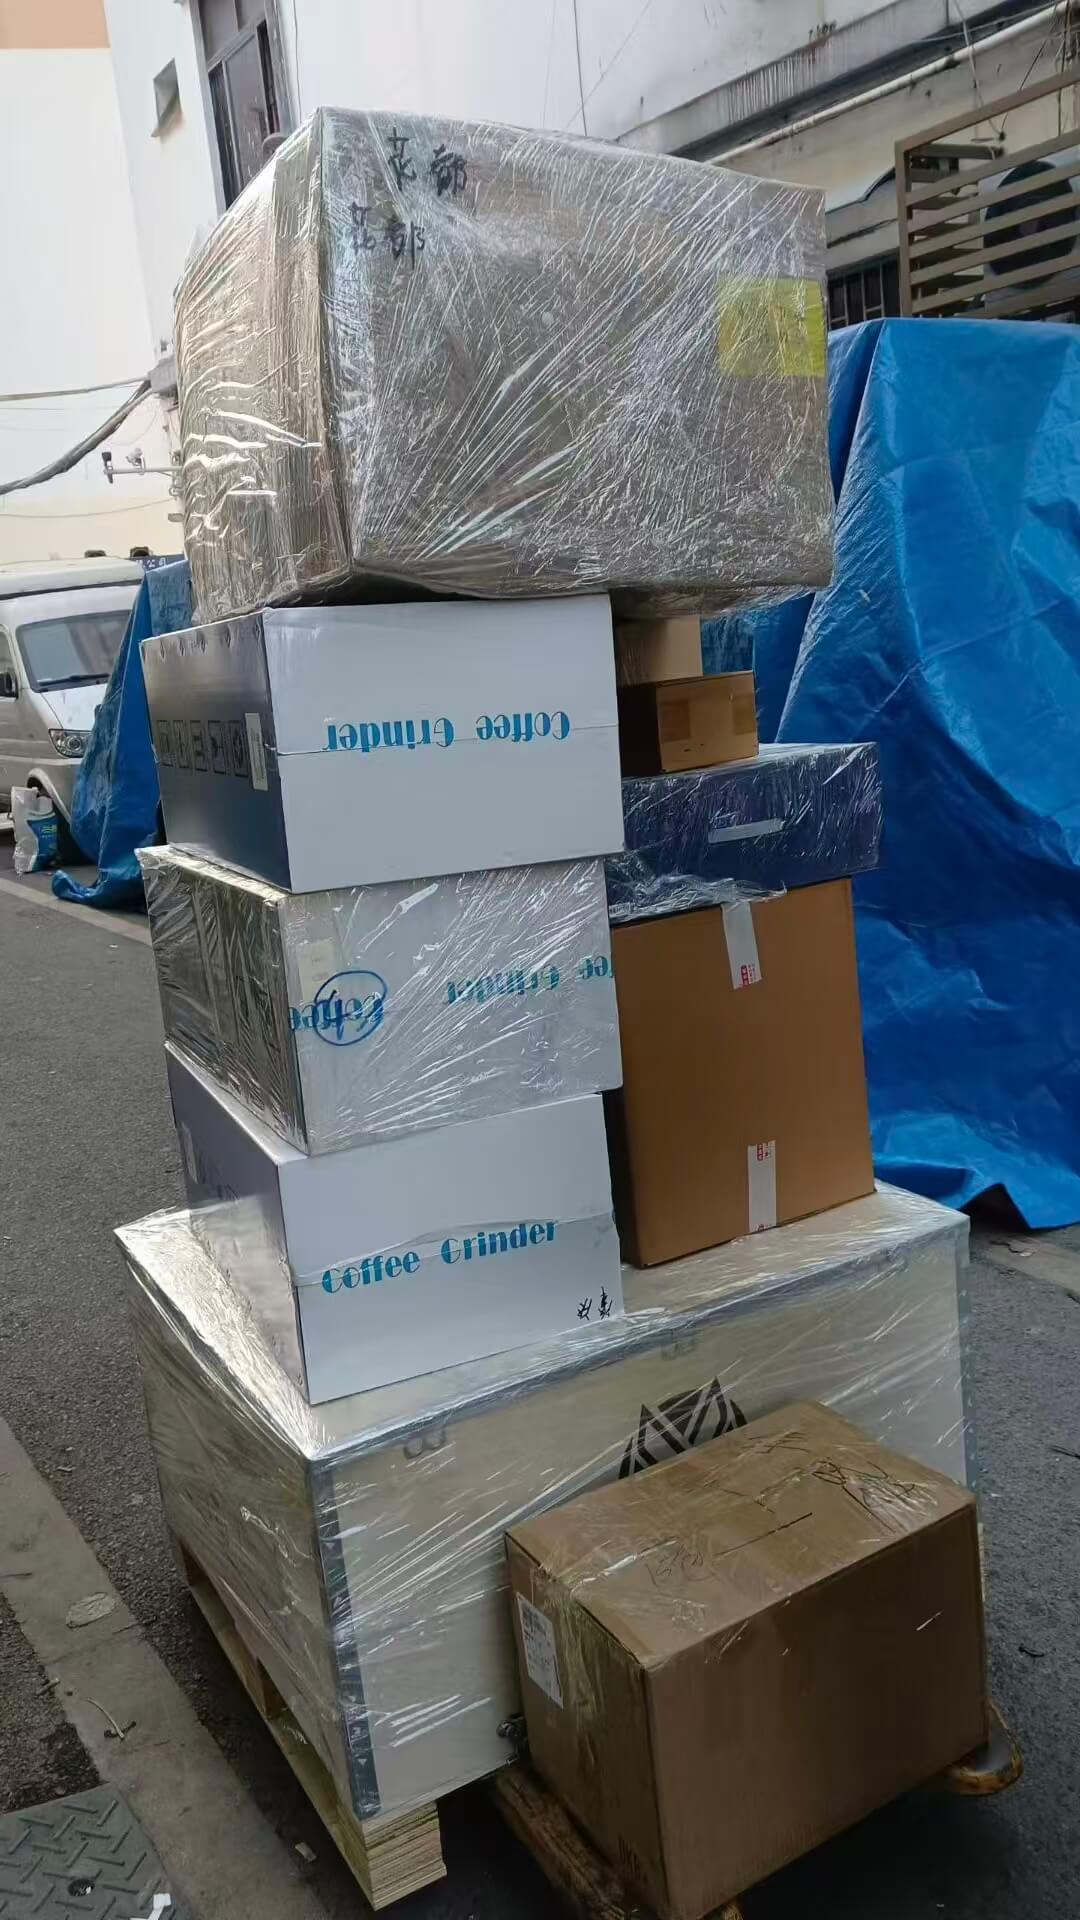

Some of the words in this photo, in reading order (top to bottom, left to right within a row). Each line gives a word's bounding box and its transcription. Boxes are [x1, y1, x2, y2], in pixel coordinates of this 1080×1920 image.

[322, 717, 455, 753] Grinder
[475, 711, 571, 742] Coffee
[321, 1250, 420, 1294] Coffee
[440, 1220, 557, 1265] Grinder
